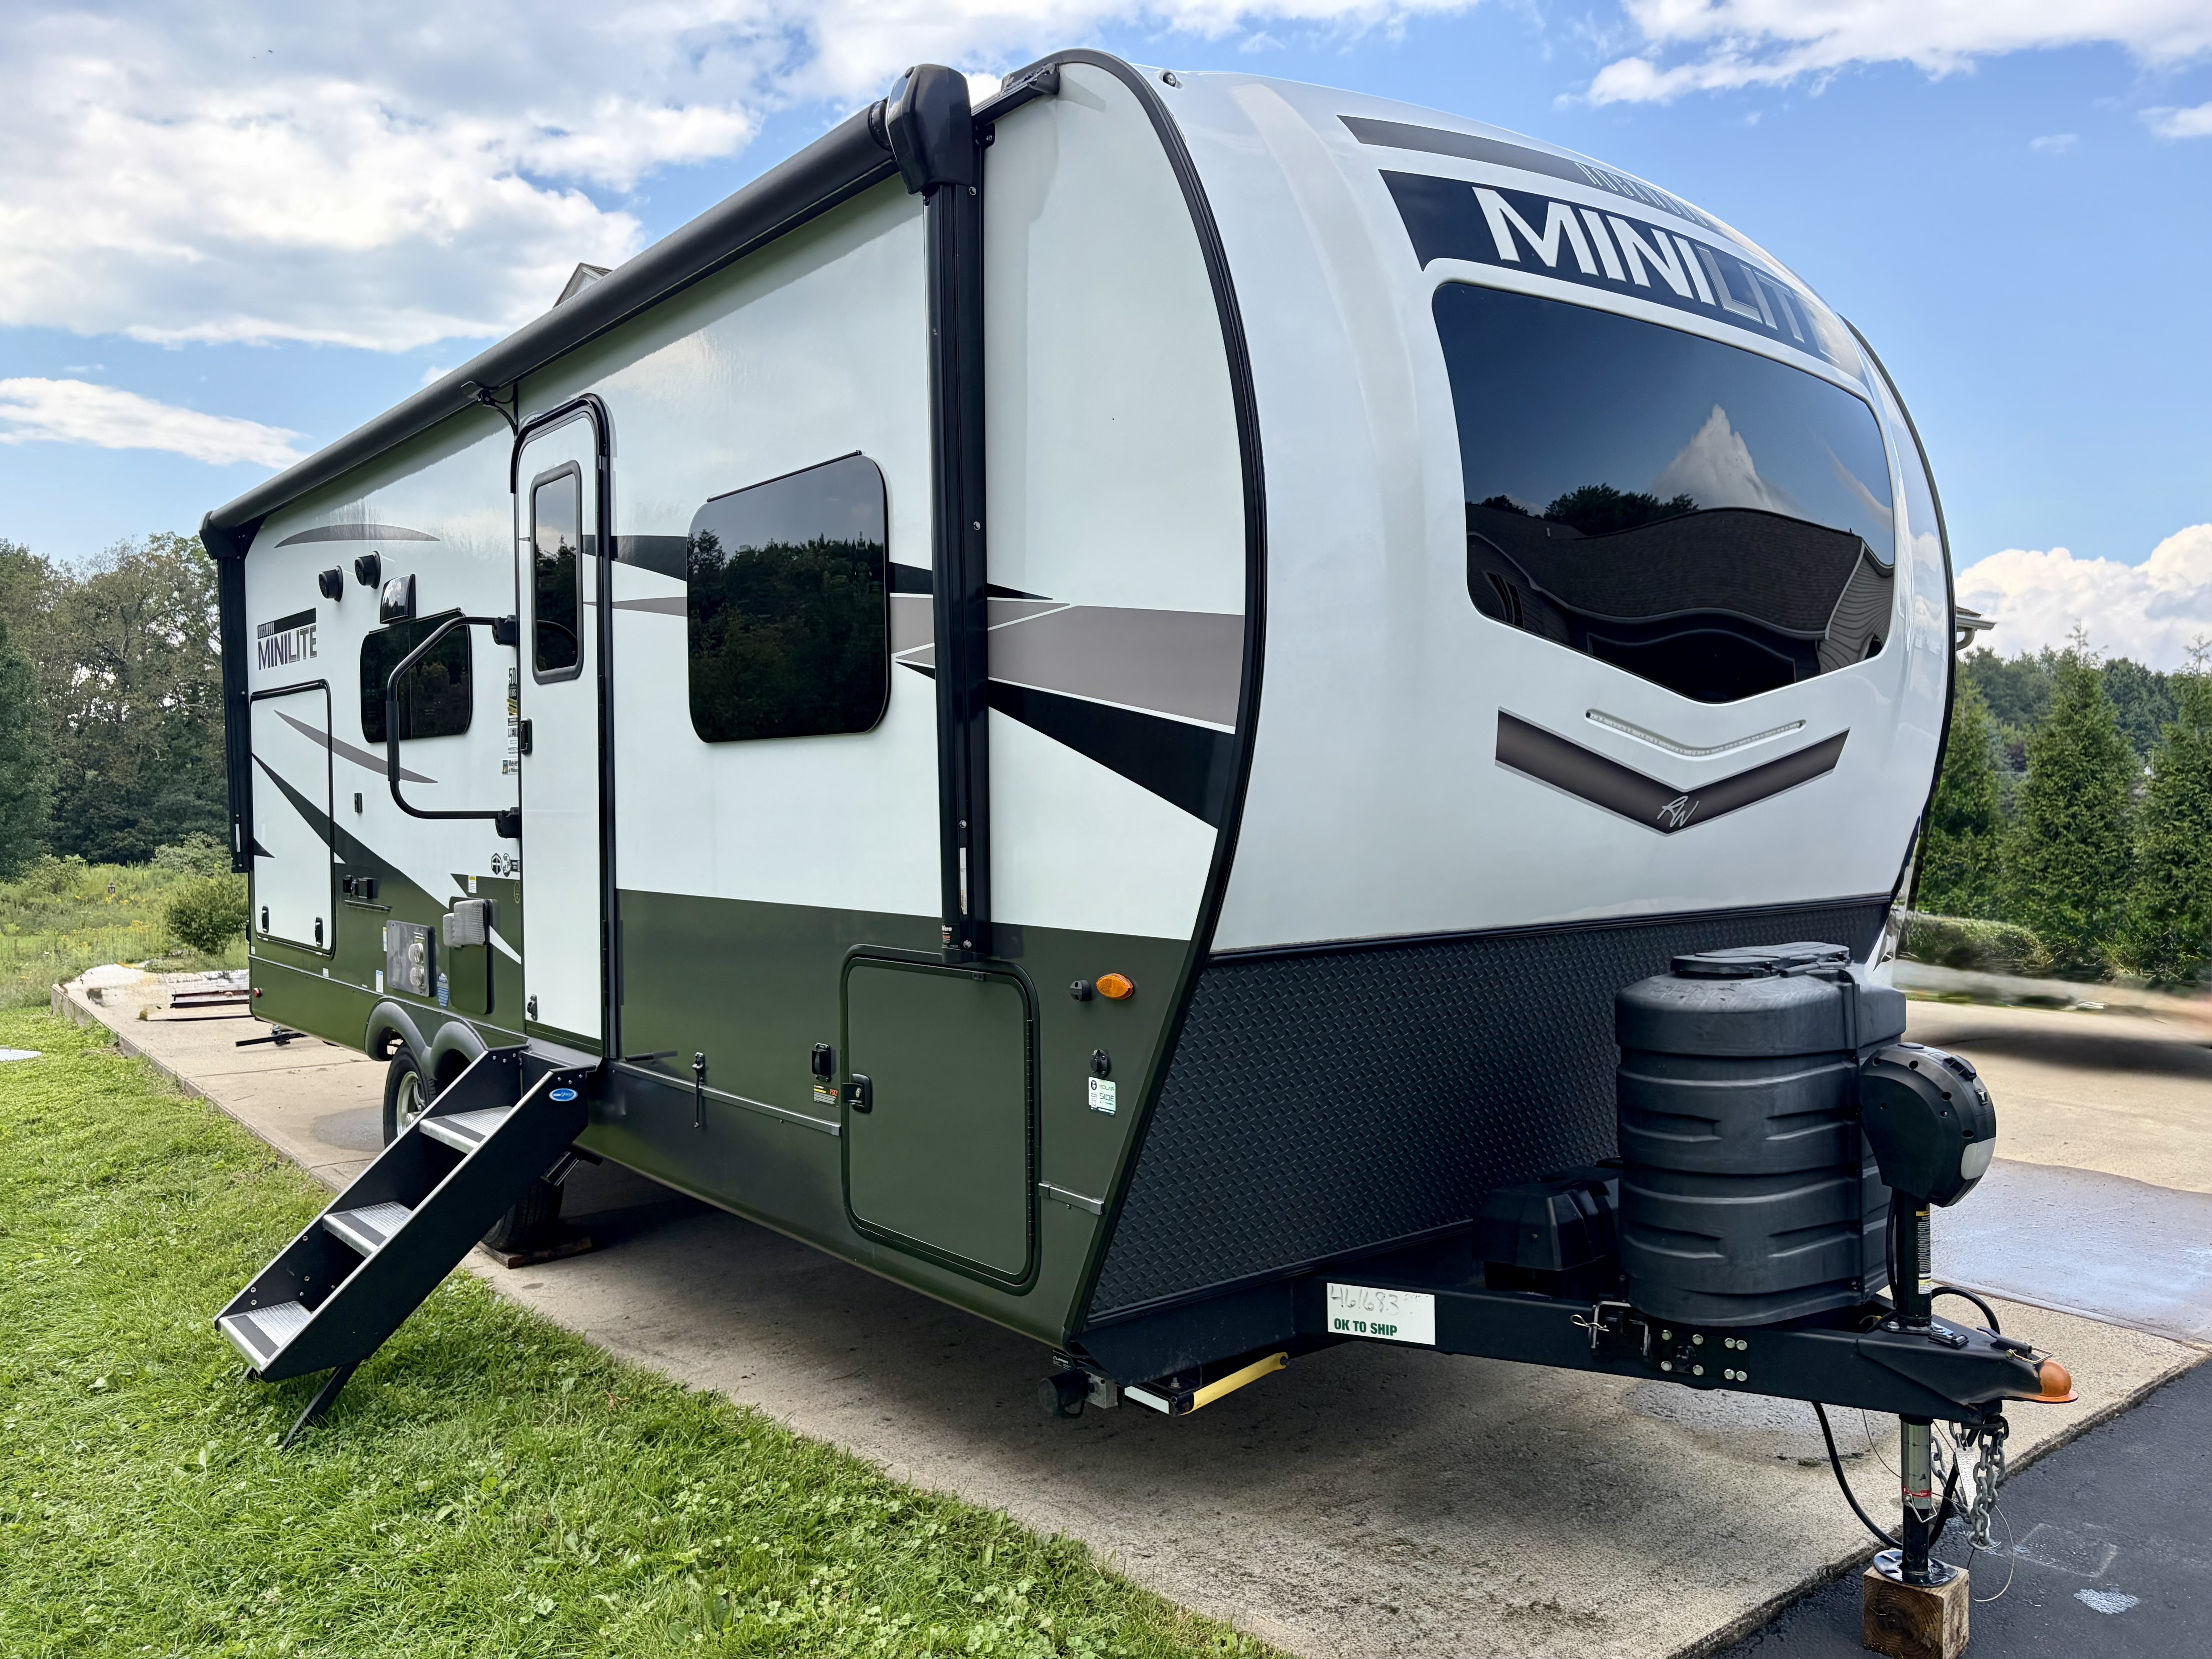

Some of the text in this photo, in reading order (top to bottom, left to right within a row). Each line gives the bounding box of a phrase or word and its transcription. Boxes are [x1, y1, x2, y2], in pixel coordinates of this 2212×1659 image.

[1574, 162, 1708, 227] ROCKWOOD
[1472, 186, 1841, 364] MINILITE
[258, 625, 317, 670] MINILITE
[1657, 795, 1699, 828] RW
[1334, 1318, 1398, 1336] OK TO SHIP
